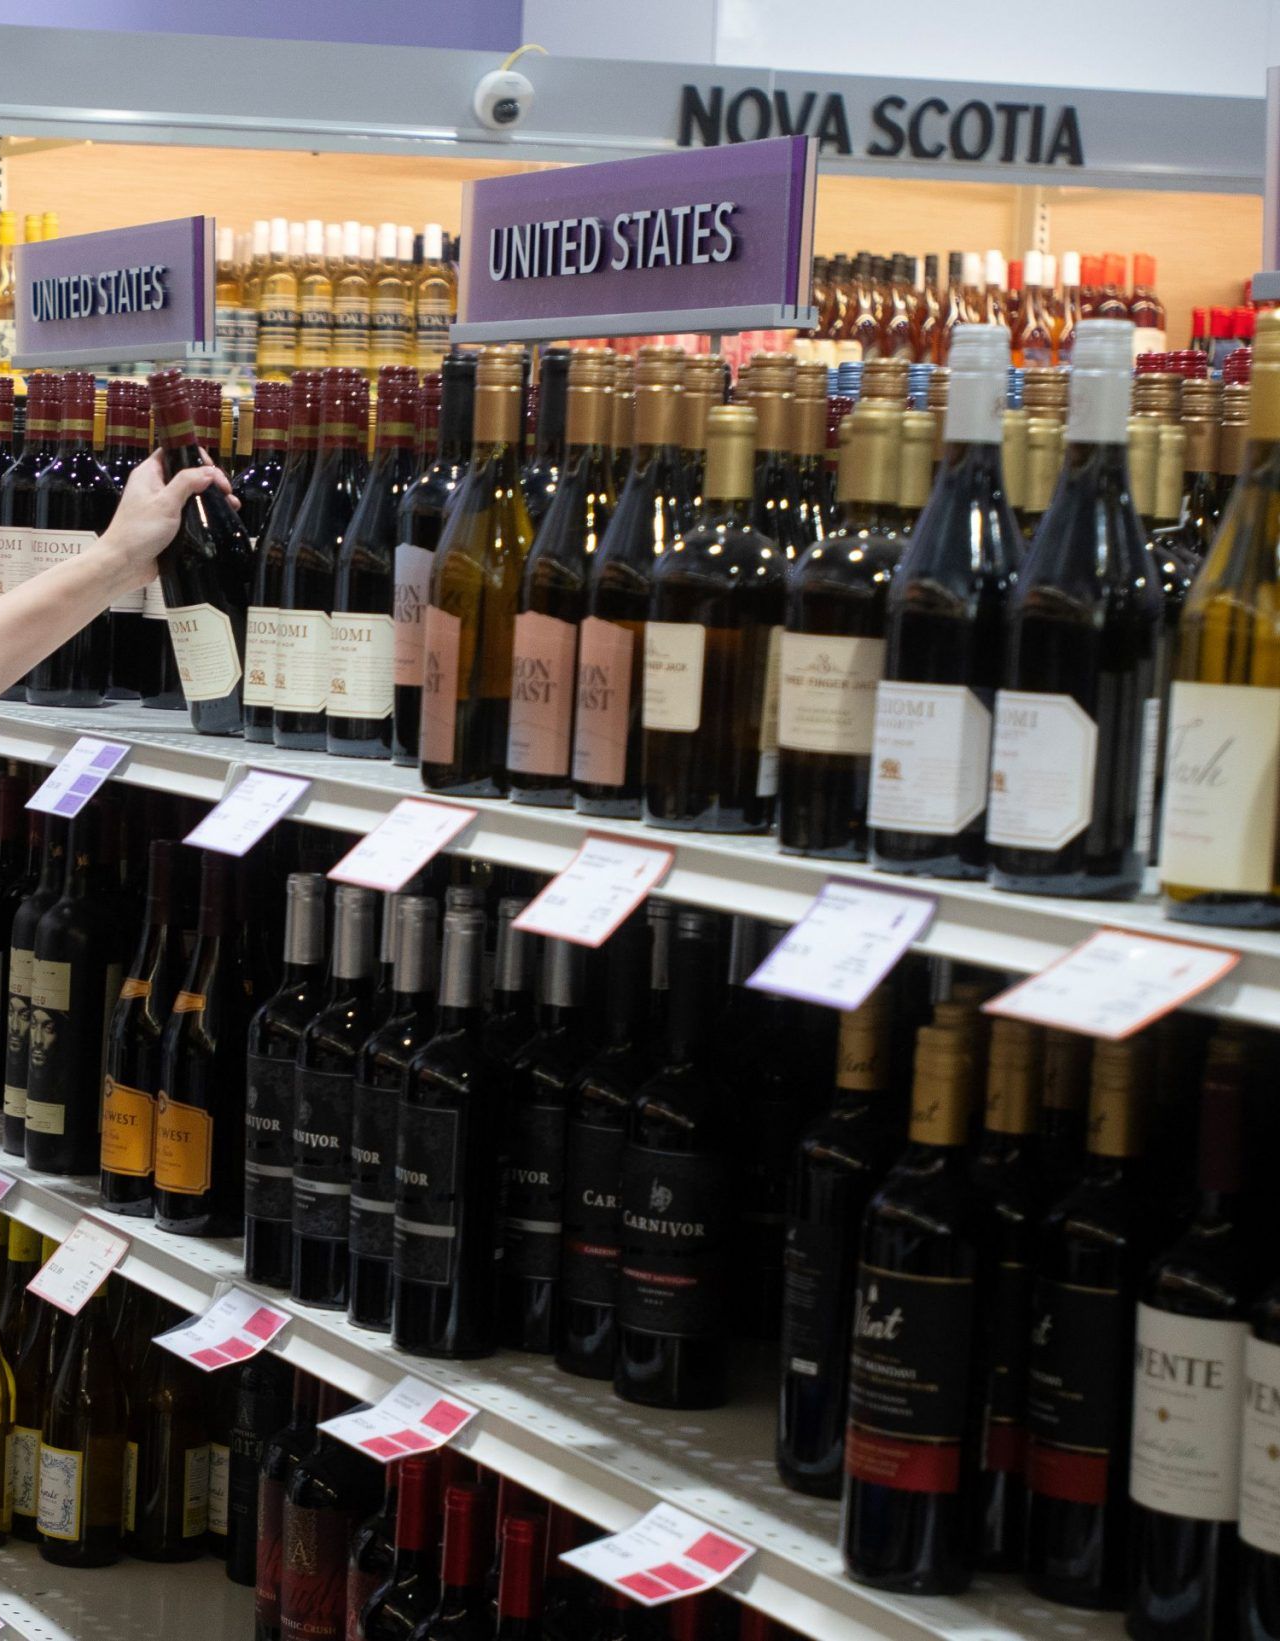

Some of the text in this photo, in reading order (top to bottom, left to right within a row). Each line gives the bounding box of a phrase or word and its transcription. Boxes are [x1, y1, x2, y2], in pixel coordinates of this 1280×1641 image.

[677, 84, 1085, 167] NOVA SCOTIA
[488, 201, 738, 282] UNITED STATES
[31, 264, 167, 323] UNITED STATES
[622, 1209, 705, 1239] CARNIVOR
